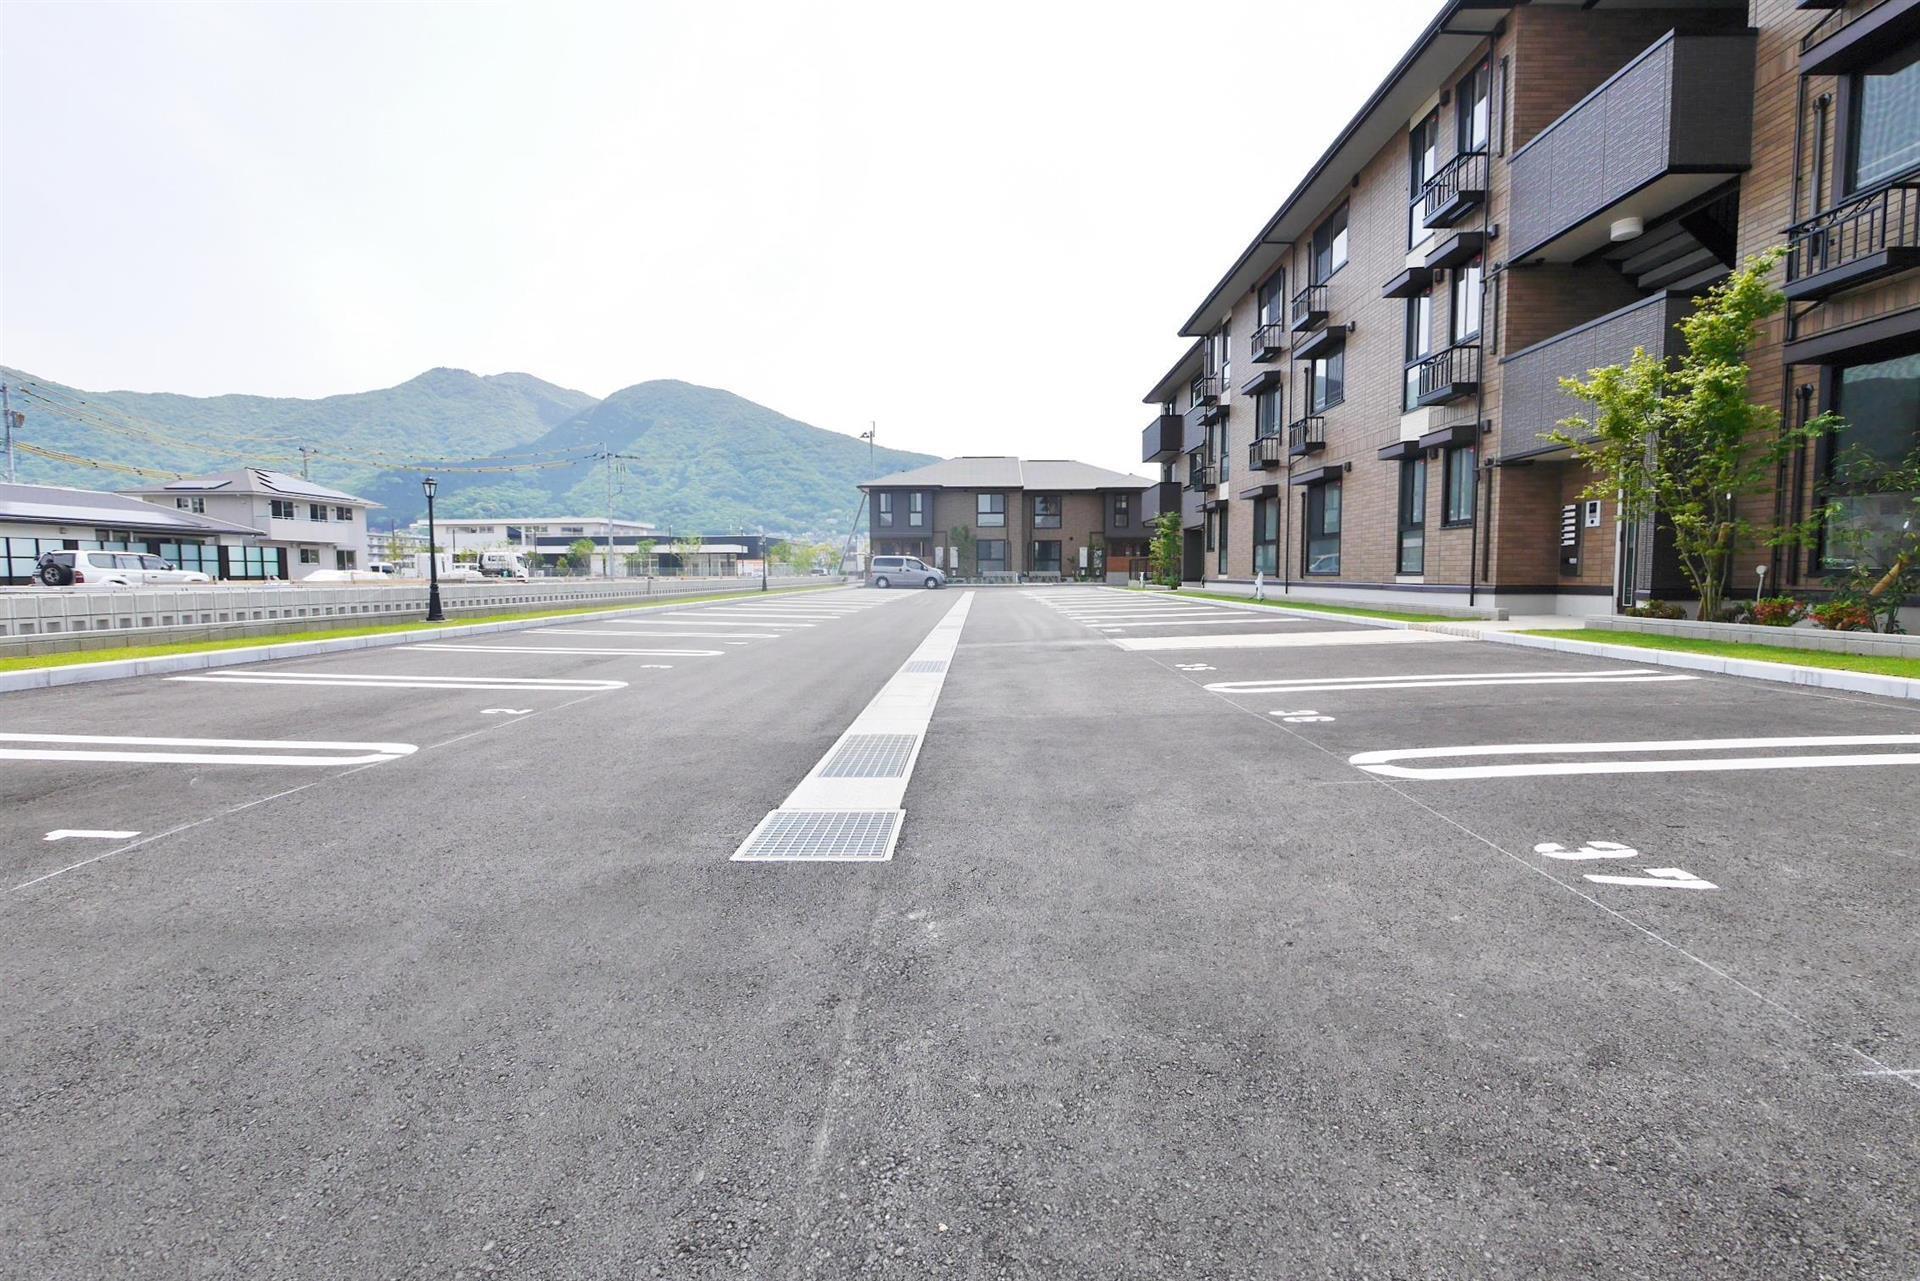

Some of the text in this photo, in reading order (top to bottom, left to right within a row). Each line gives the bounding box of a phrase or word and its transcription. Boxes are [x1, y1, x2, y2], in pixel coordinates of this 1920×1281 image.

[480, 707, 534, 715] 2
[1269, 708, 1336, 723] 36
[43, 829, 142, 841] 1
[1533, 840, 1720, 890] 37
